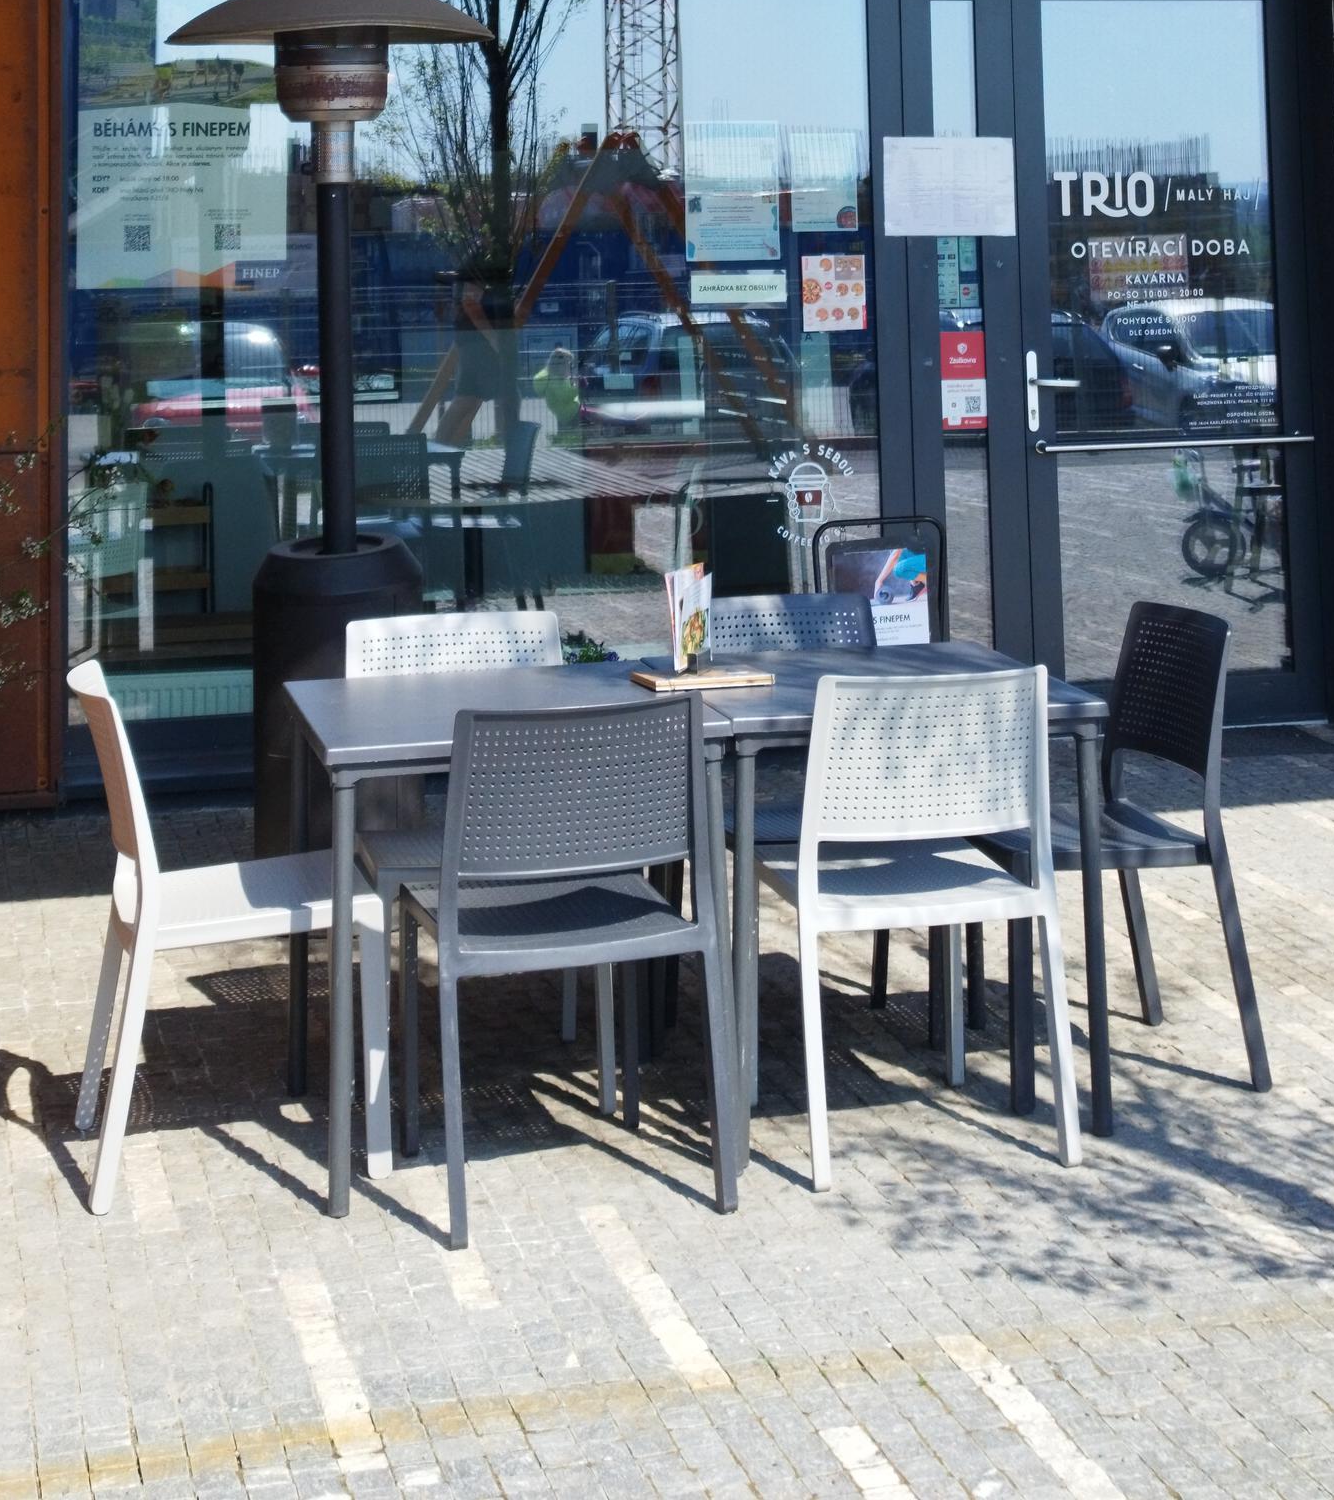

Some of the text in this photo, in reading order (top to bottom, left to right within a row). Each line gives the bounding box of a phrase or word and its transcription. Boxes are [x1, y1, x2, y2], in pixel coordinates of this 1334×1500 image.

[93, 117, 250, 138] BĚHÁM S FINEPEM
[1053, 171, 1155, 218] TRIO
[1071, 235, 1251, 259] OTEVÍRACÍ DOBA
[242, 268, 280, 279] FINEP
[1125, 270, 1185, 285] KAVÁRNA
[698, 284, 734, 293] ZAHRÁDKA
[735, 284, 748, 293] BEZ
[1107, 290, 1139, 300] PO-SO
[1144, 289, 1168, 299] 10:00
[1179, 288, 1204, 298] 20:00
[1117, 314, 1197, 325] POHYBOVÉ SUDIO
[1129, 329, 1142, 337] DLE
[768, 443, 854, 479] KÁVA S SEBOU
[777, 526, 812, 547] COFFEE
[879, 614, 911, 624] FINEPEM
